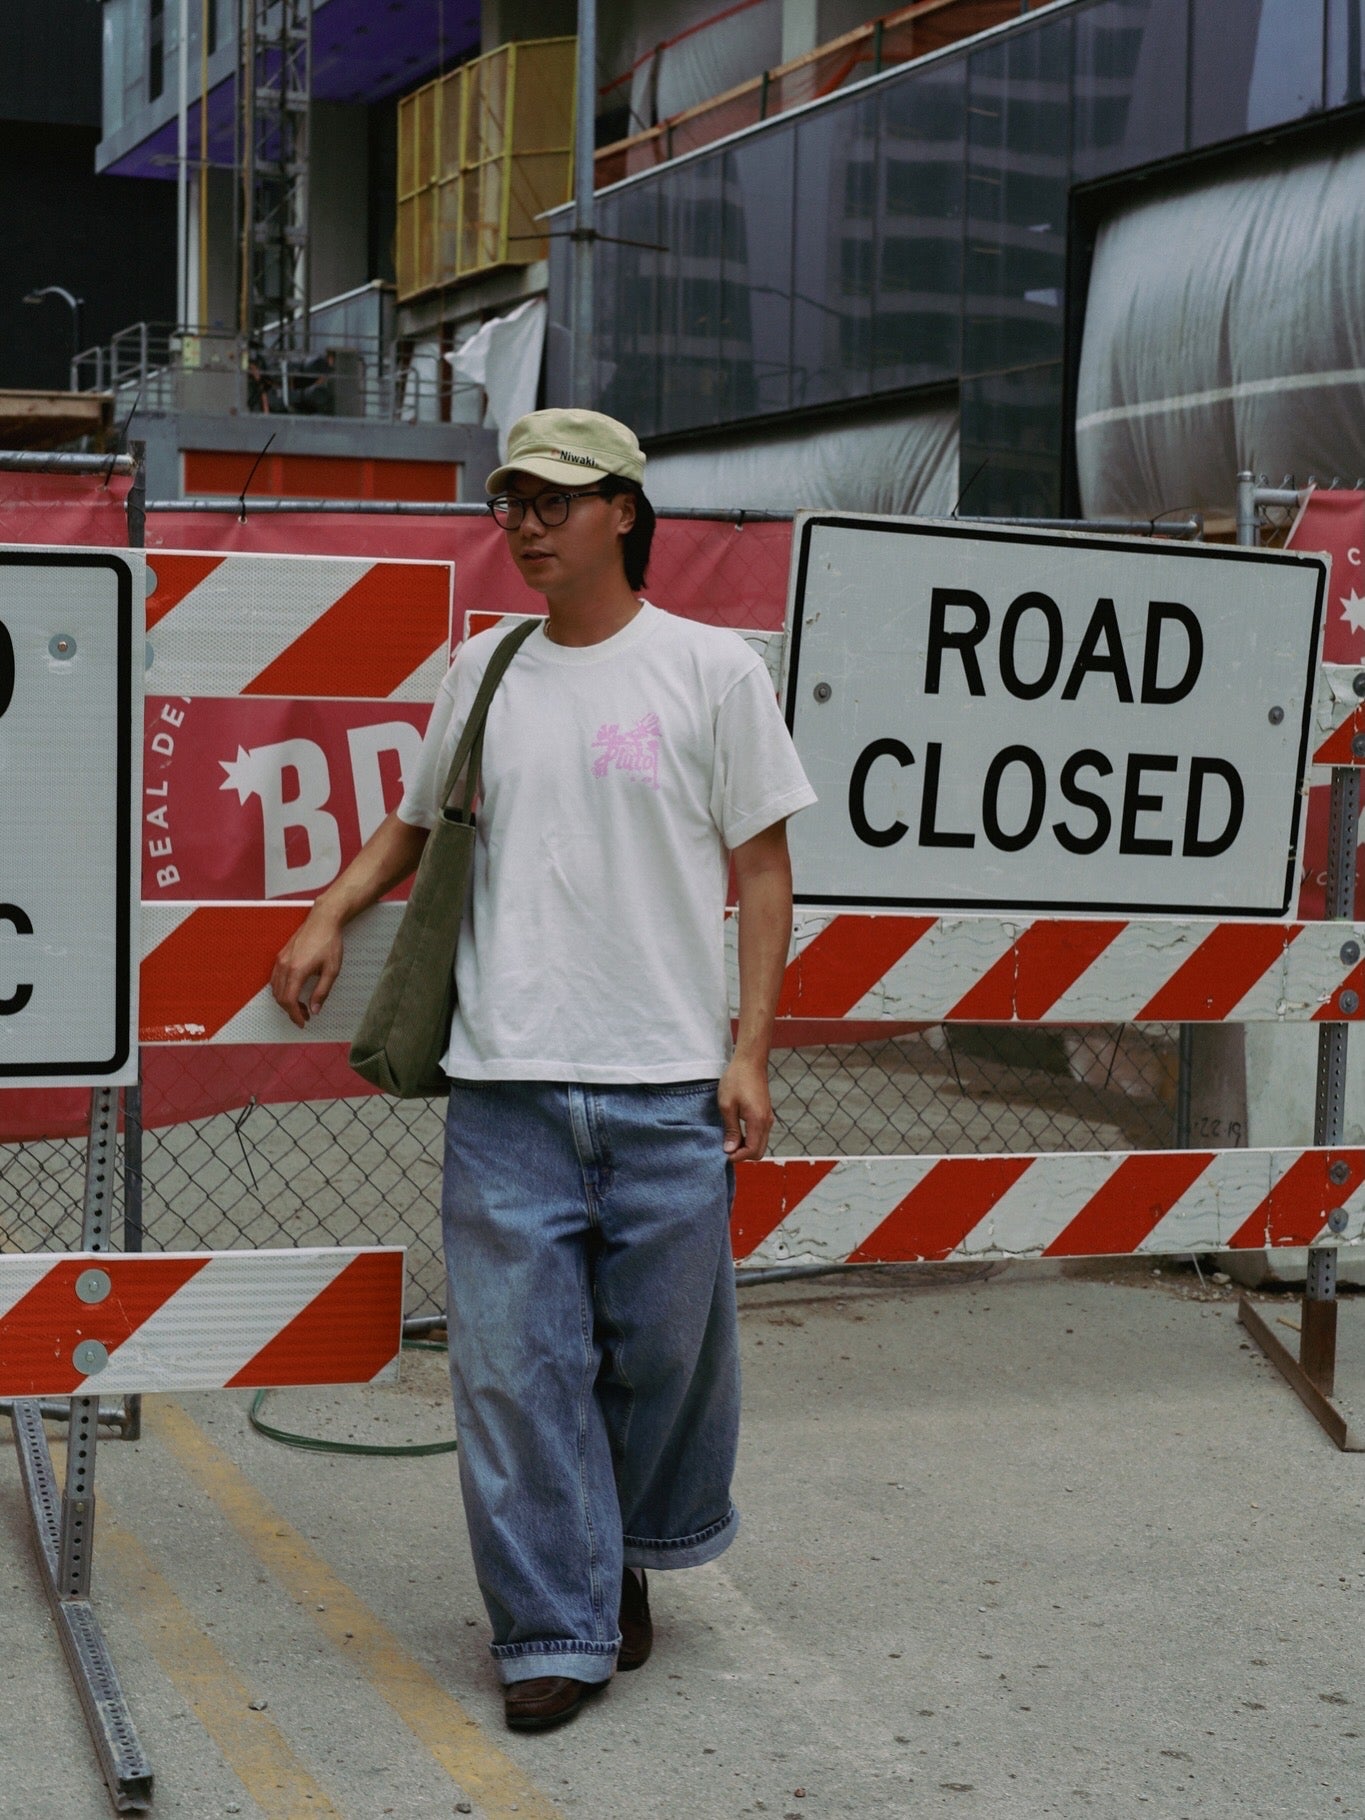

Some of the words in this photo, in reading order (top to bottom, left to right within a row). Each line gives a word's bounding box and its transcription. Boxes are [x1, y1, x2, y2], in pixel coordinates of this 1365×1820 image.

[560, 450, 595, 466] Niwaki
[924, 587, 1204, 705] ROAD
[151, 696, 192, 757] DE
[146, 780, 181, 888] BEAL
[848, 737, 1245, 858] CLOSED
